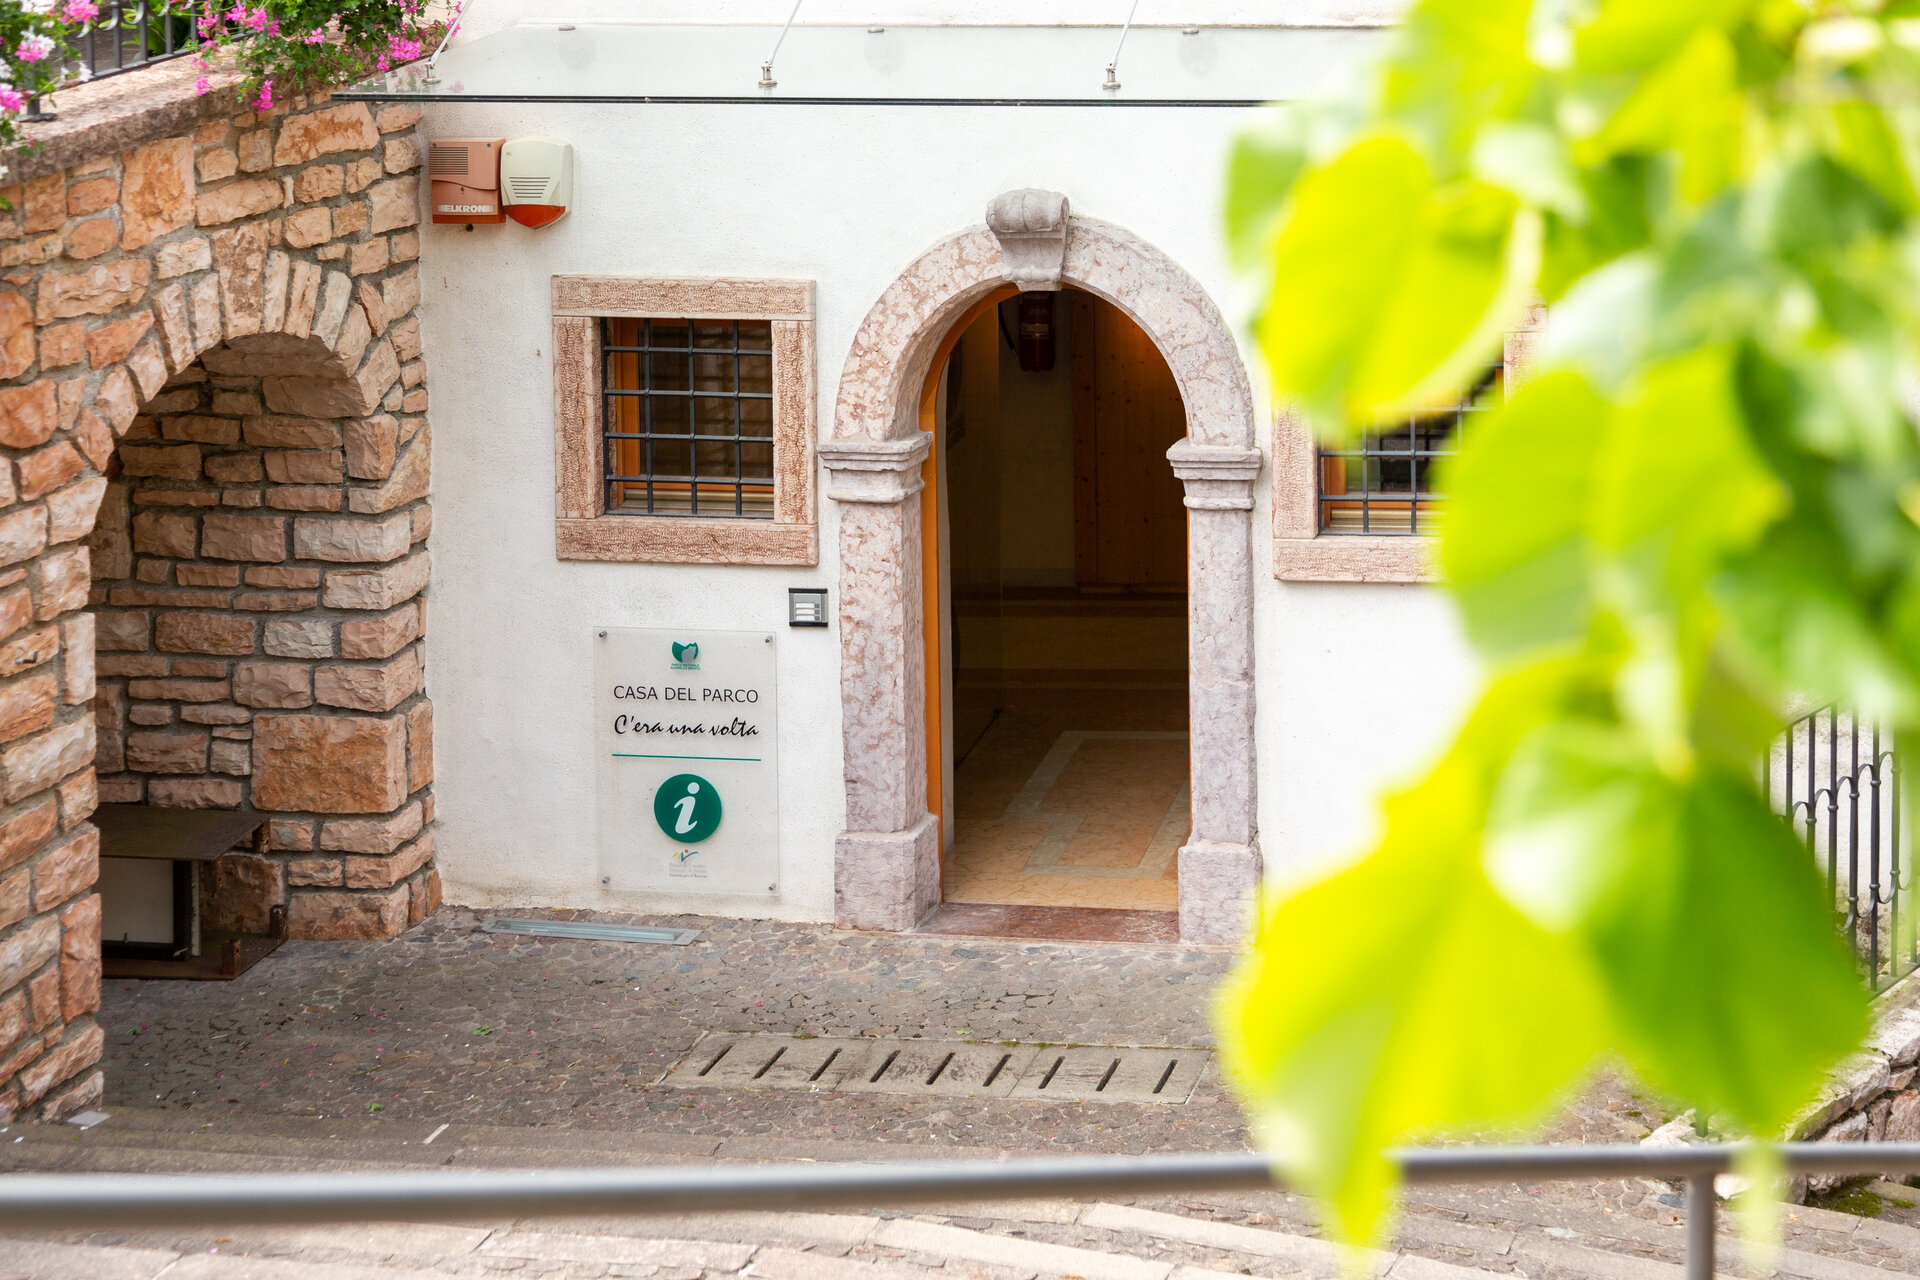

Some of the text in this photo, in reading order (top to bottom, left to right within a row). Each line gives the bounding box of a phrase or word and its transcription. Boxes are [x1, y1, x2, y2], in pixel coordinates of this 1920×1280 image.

[444, 204, 486, 213] ELKRON
[613, 685, 759, 703] CASA DEL PARCO
[614, 714, 759, 737] C'era una volta
